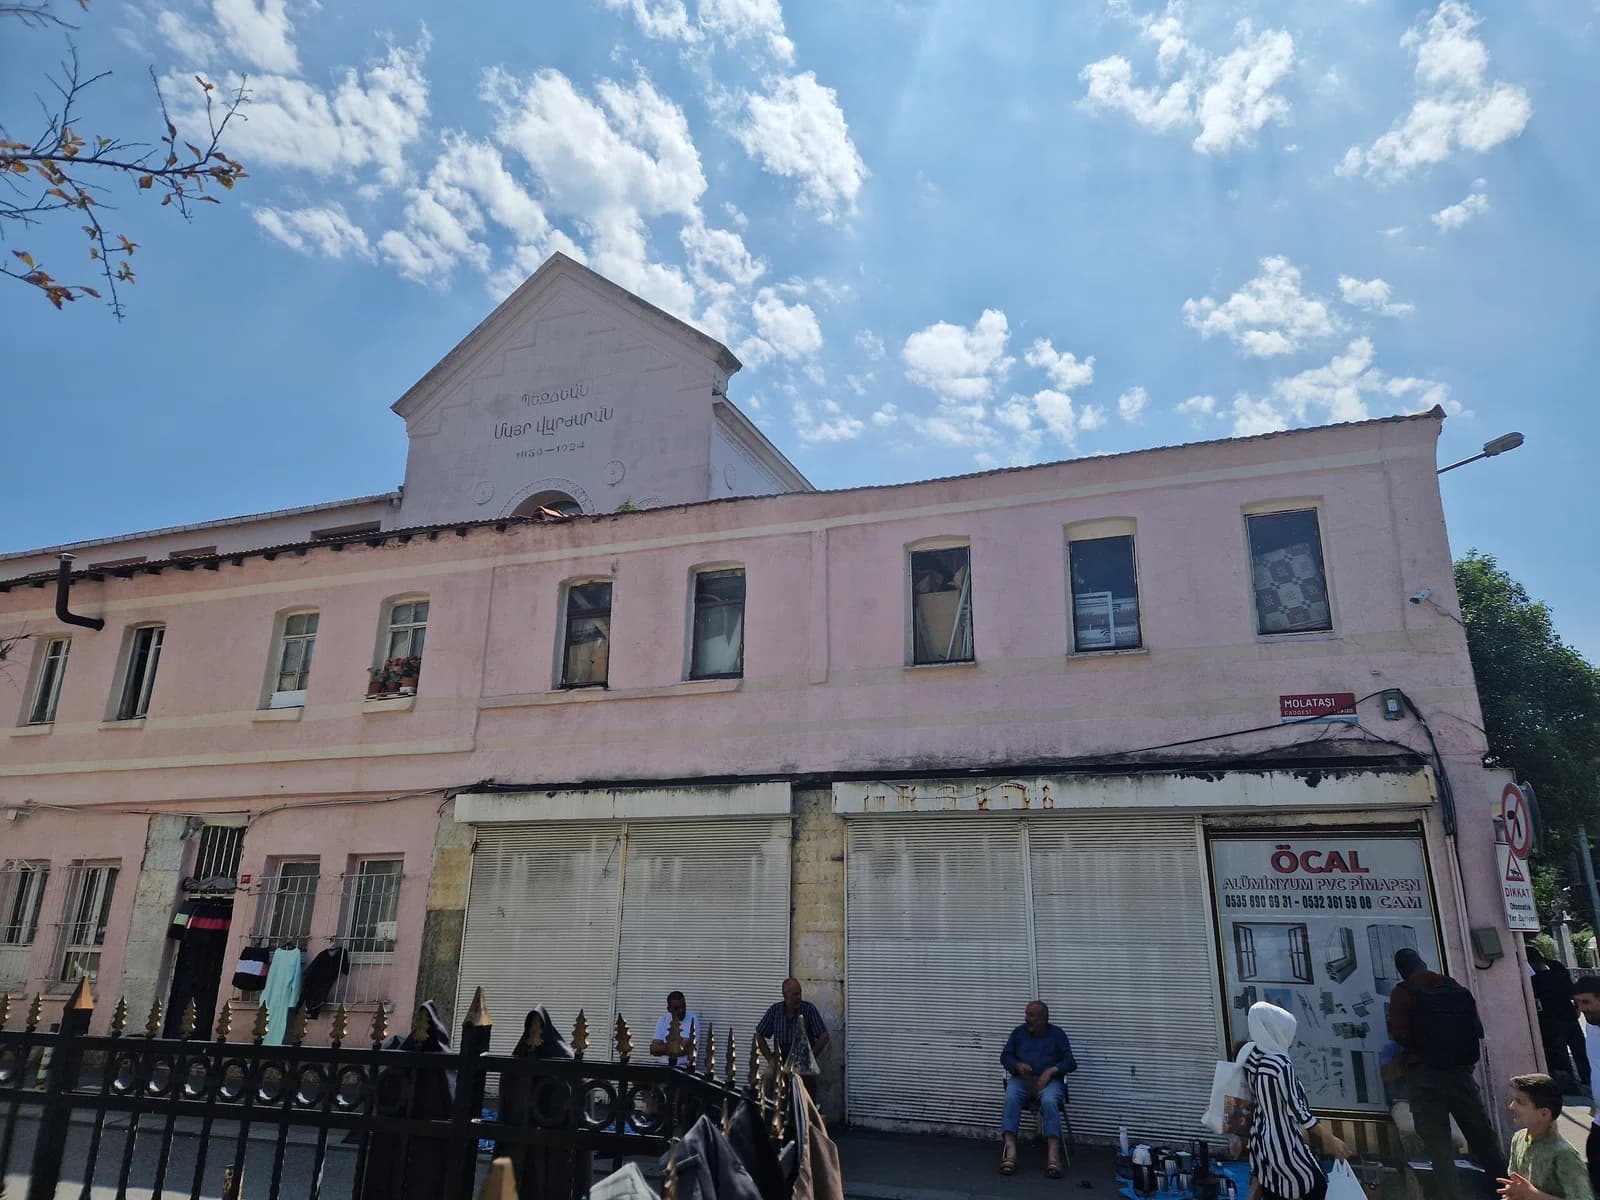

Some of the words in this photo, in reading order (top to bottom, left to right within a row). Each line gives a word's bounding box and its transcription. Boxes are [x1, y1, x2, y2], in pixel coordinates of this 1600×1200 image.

[1284, 697, 1336, 708] MOLATAŞI
[1270, 844, 1370, 874] ÖCAL
[1222, 875, 1313, 891] ALÜMİNYUM
[1316, 878, 1347, 891] PVC
[1349, 875, 1421, 892] PİMAPEN
[1225, 894, 1247, 908] 0535
[1282, 895, 1292, 909] 31
[1302, 895, 1325, 909] 0532
[1345, 895, 1357, 910] 59
[1379, 895, 1422, 909] CAM
